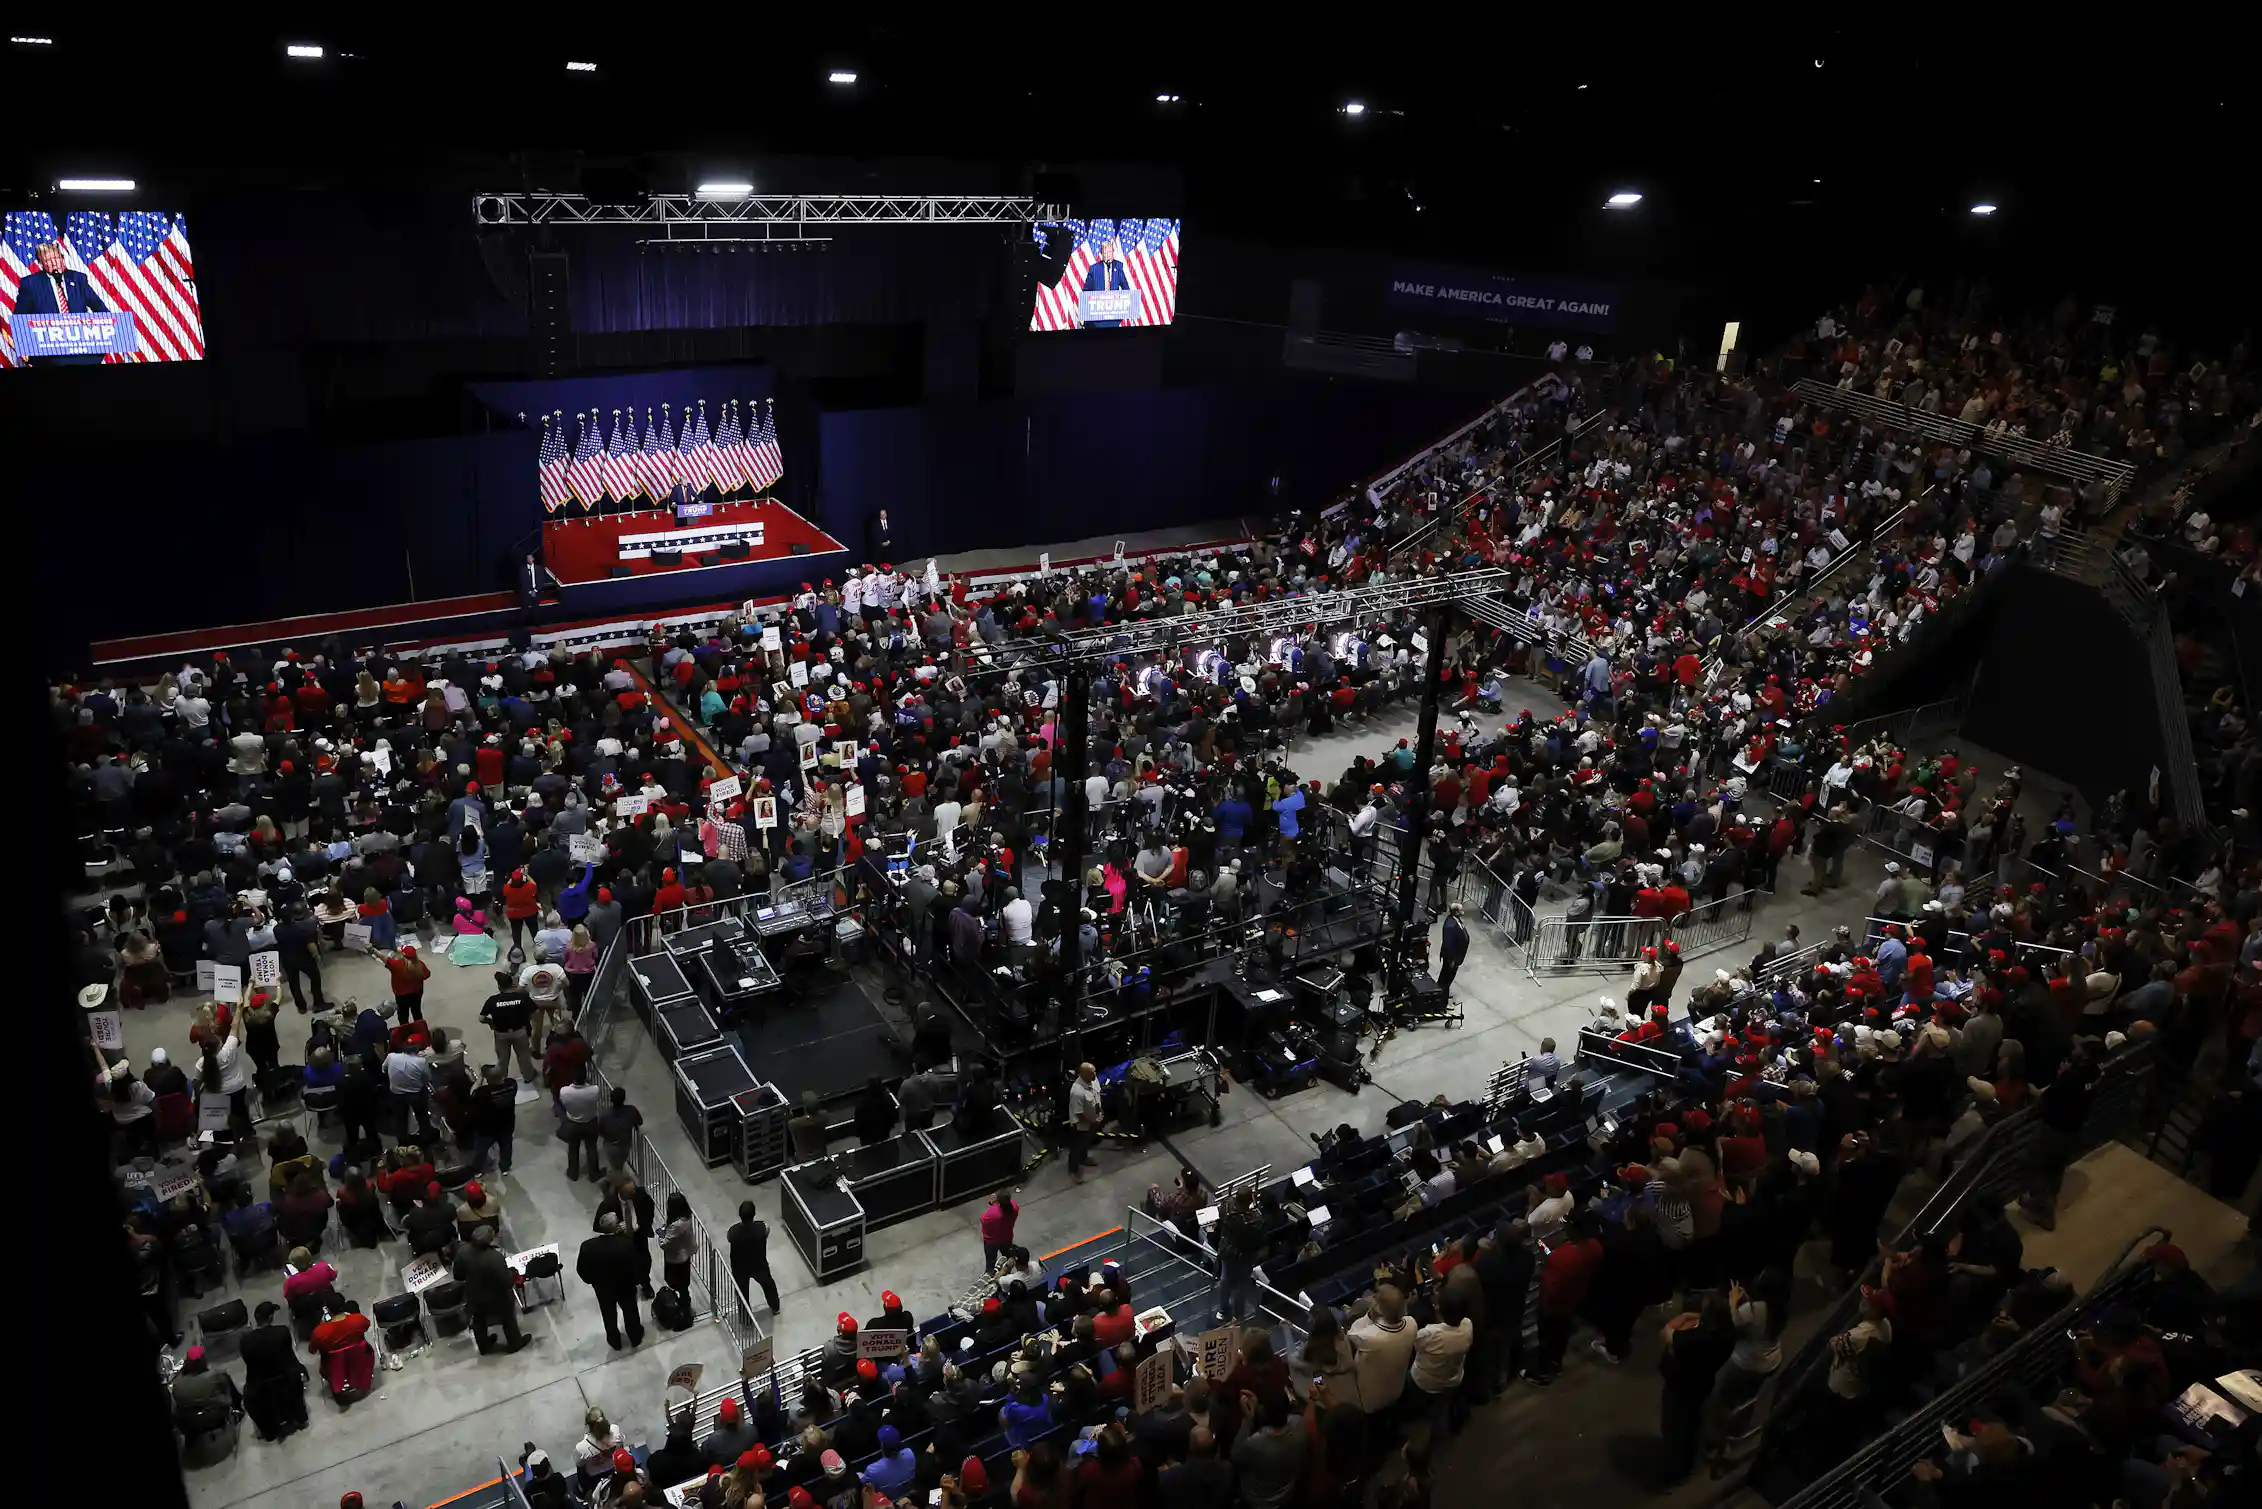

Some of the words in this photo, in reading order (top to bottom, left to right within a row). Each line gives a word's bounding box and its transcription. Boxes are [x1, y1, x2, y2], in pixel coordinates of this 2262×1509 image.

[1088, 299, 1131, 312] TRUMP
[1393, 280, 1434, 297] MAKE
[1436, 287, 1502, 304] AMERICA
[1506, 295, 1555, 310] GREAT
[1557, 300, 1610, 316] AGAIN!
[32, 324, 116, 343] TRUMP
[716, 787, 737, 798] FIRED!
[255, 958, 263, 982] TRUMP
[261, 955, 270, 983] DONALD
[268, 959, 276, 979] VOTE
[496, 1000, 522, 1008] SECURITY
[162, 1176, 194, 1196] FIRED!
[408, 1262, 438, 1283] DONALD
[412, 1260, 429, 1273] VOTE
[412, 1270, 437, 1287] TRUMP
[862, 1339, 902, 1347] DONALD
[865, 1344, 900, 1353] TRUMP
[1204, 1339, 1217, 1379] FIRE
[1216, 1336, 1228, 1378] BIDEN
[1140, 1367, 1149, 1406] TRUMP
[1148, 1360, 1157, 1404] DONALD
[1156, 1363, 1165, 1394] VOTE
